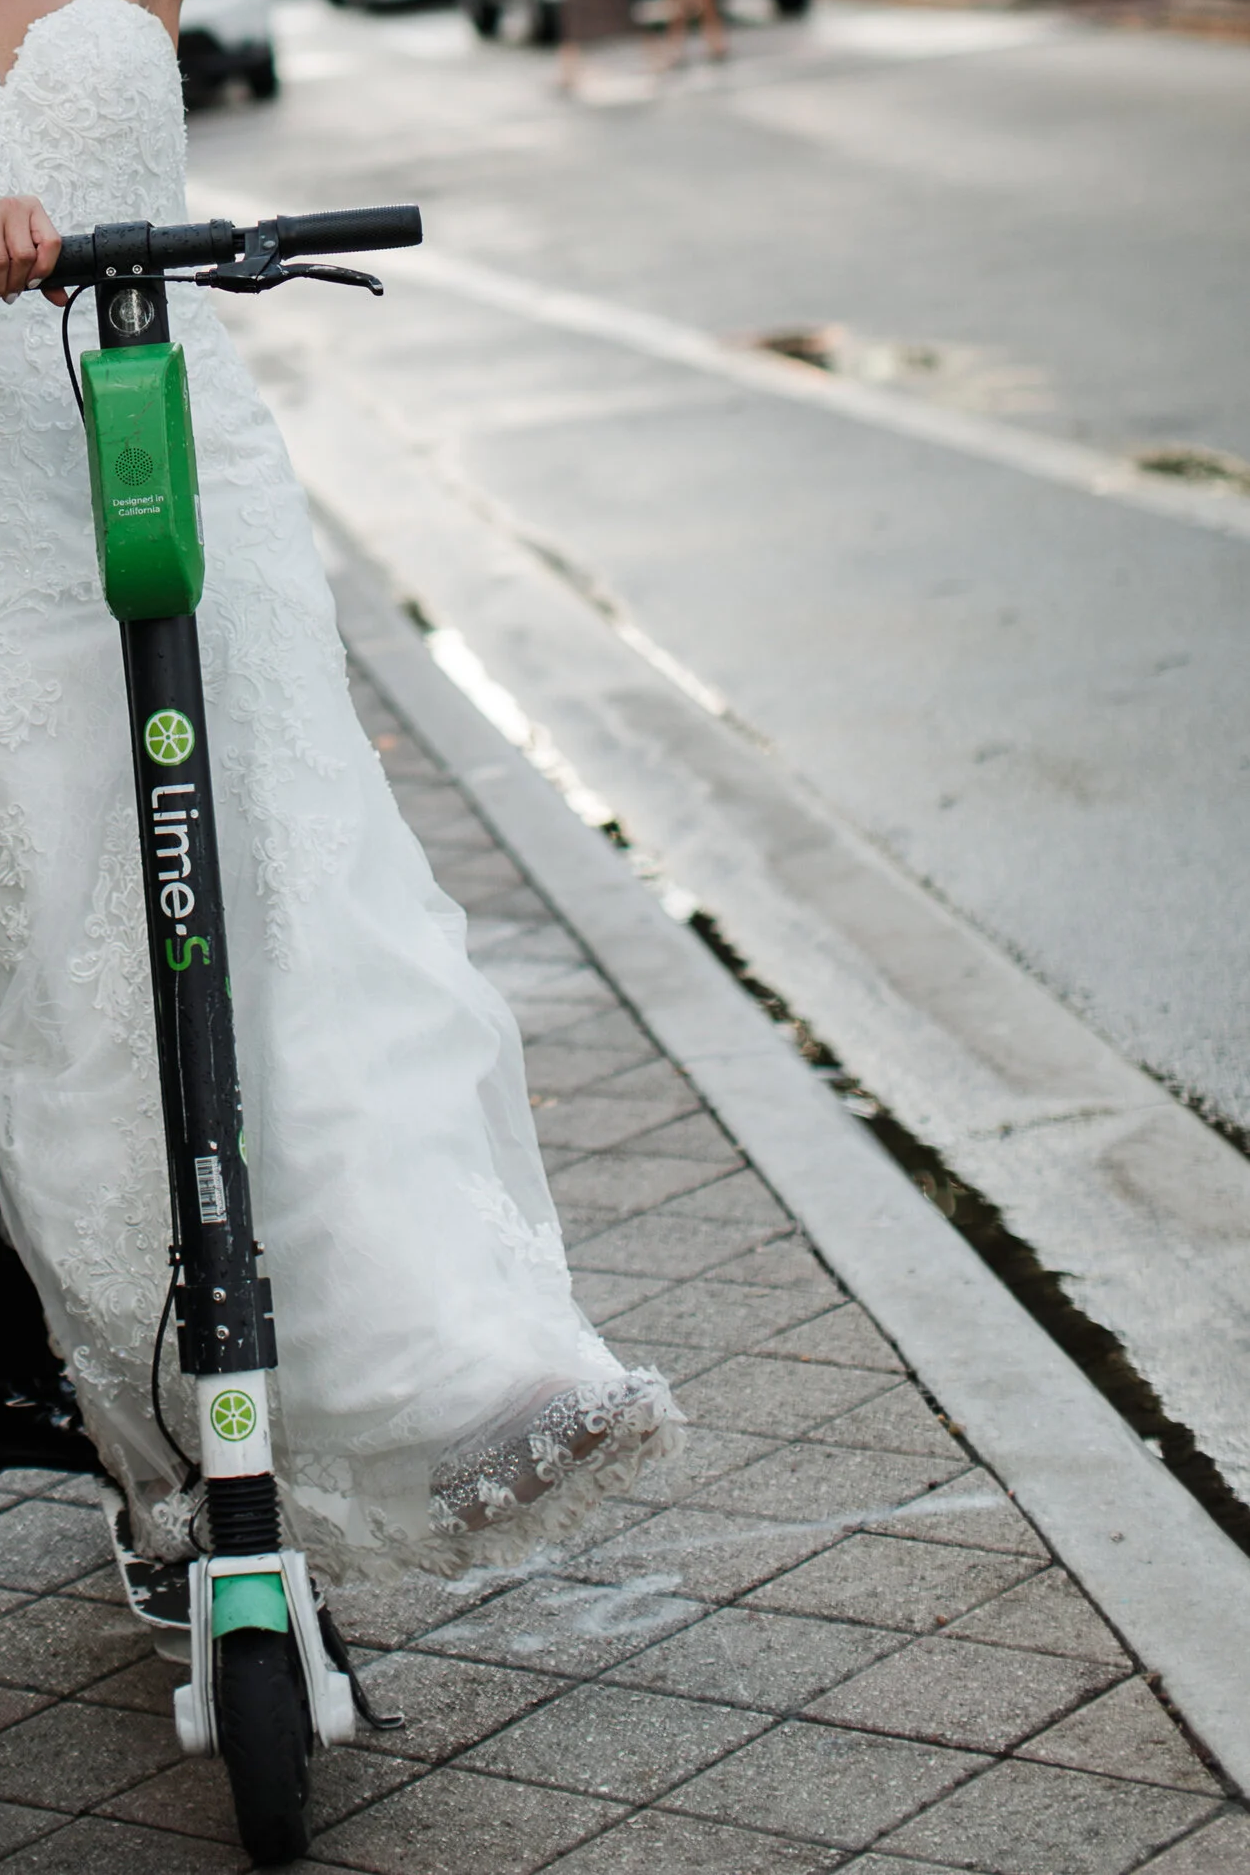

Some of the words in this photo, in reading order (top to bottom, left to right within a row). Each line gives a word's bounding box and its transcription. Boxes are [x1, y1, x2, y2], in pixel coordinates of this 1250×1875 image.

[112, 494, 153, 506] Designed
[155, 494, 164, 502] in
[118, 506, 161, 516] California
